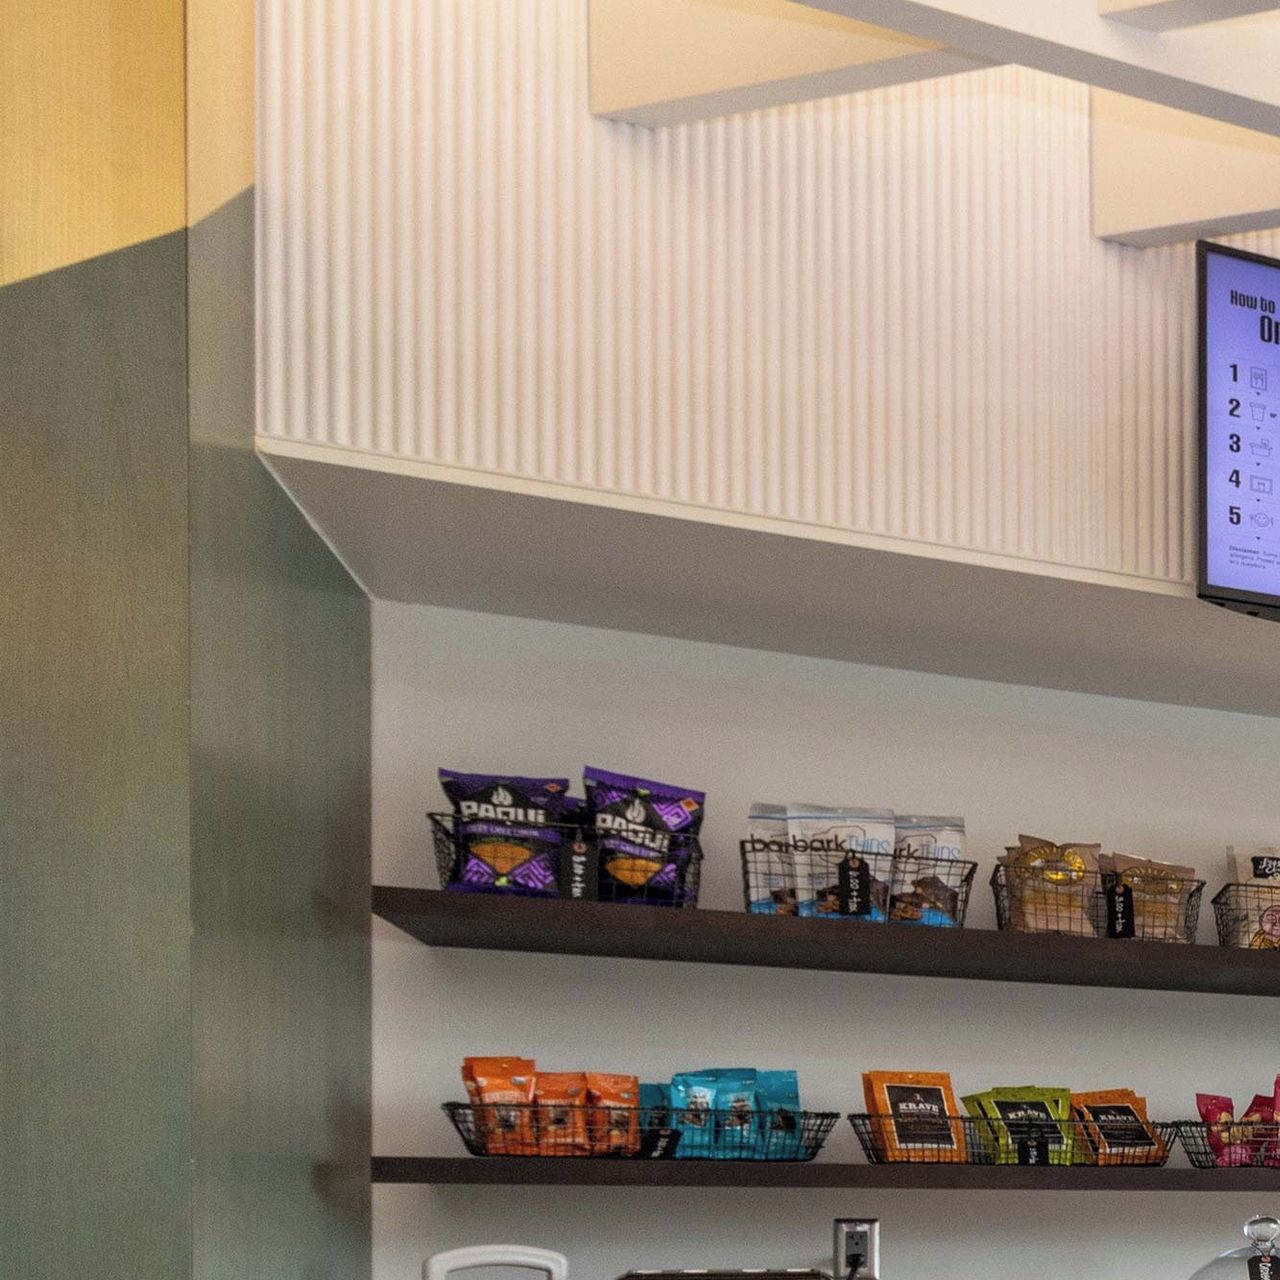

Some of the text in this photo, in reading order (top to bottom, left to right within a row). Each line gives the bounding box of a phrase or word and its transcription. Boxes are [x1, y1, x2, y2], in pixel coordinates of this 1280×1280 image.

[1230, 289, 1276, 314] How to
[1229, 364, 1238, 382] 1
[1228, 398, 1241, 418] 2
[1229, 433, 1241, 453] 3
[1228, 469, 1241, 488] 4
[1229, 505, 1241, 525] 5
[792, 834, 847, 853] bark
[899, 1102, 939, 1113] KRAVE
[1008, 1109, 1047, 1120] KRAVE
[1099, 1114, 1136, 1124] KRAVE
